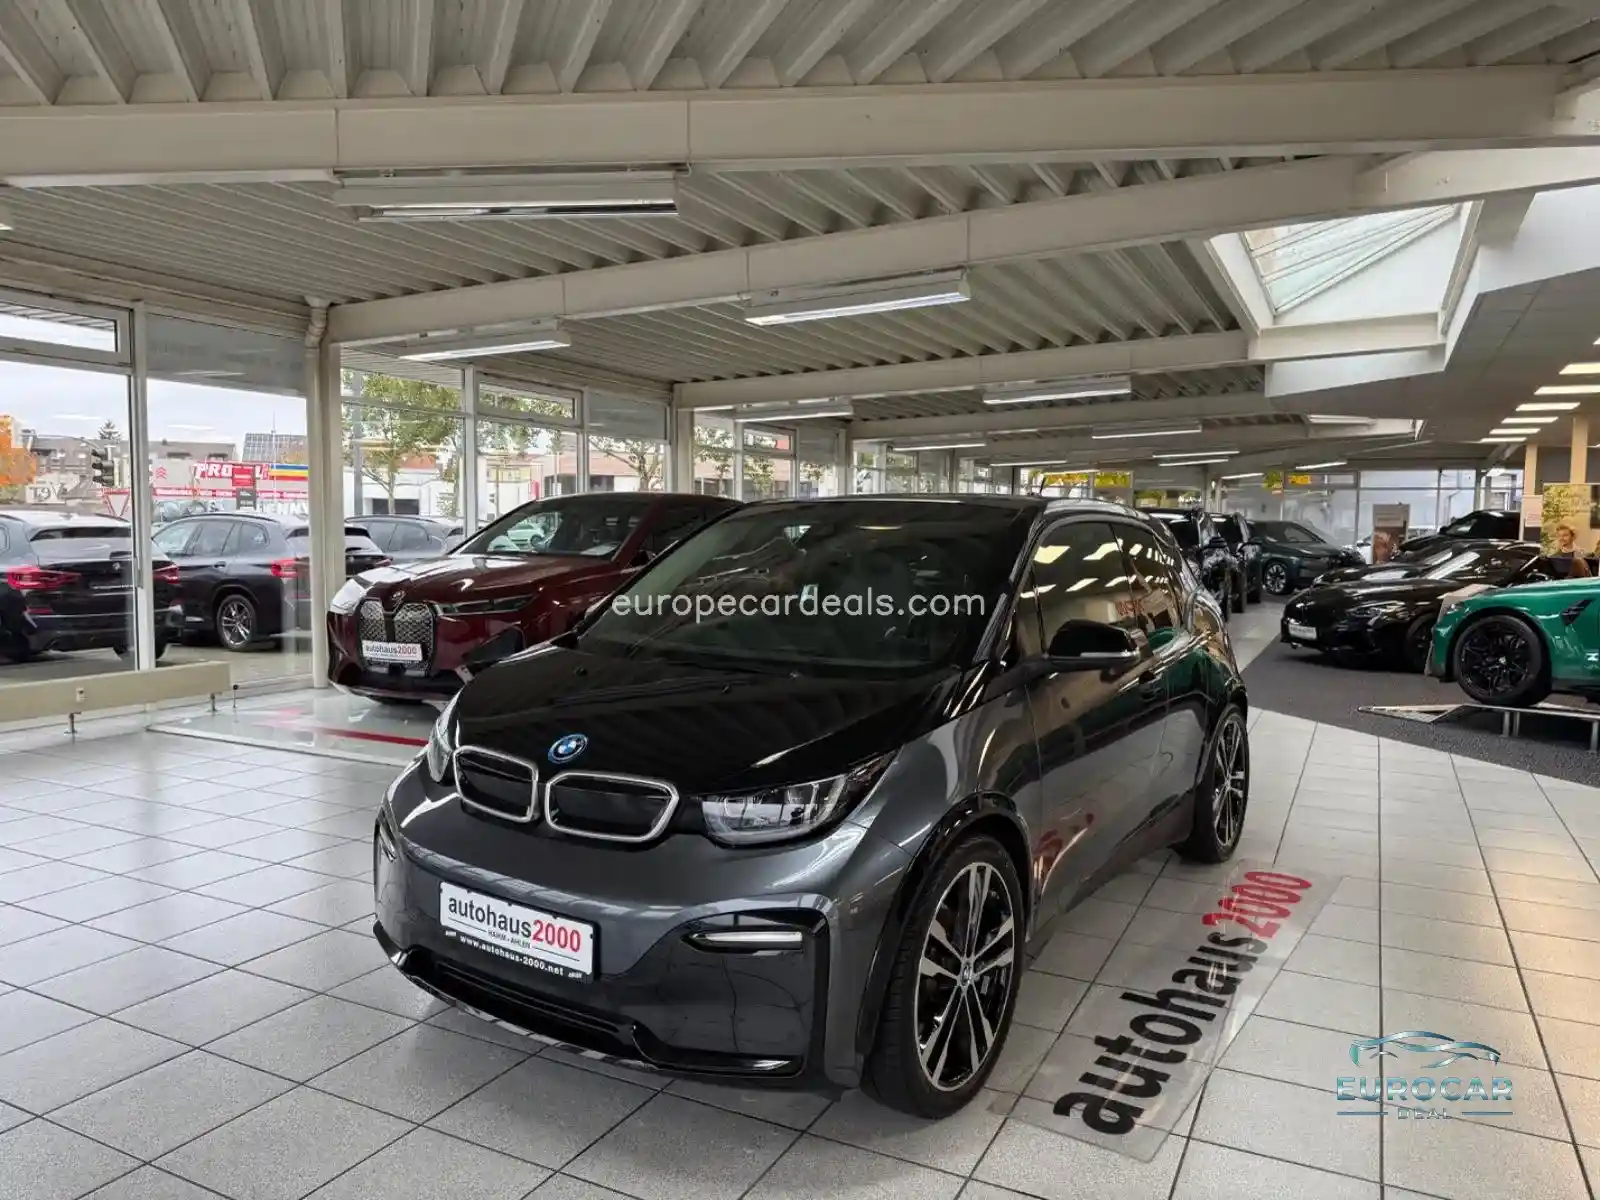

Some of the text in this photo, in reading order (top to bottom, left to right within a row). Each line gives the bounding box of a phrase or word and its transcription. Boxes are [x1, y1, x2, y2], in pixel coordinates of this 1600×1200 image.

[448, 896, 581, 953] autohaus2000
[460, 936, 564, 976] www.autohaus-2000.net
[1053, 871, 1312, 1135] autohaus2000
